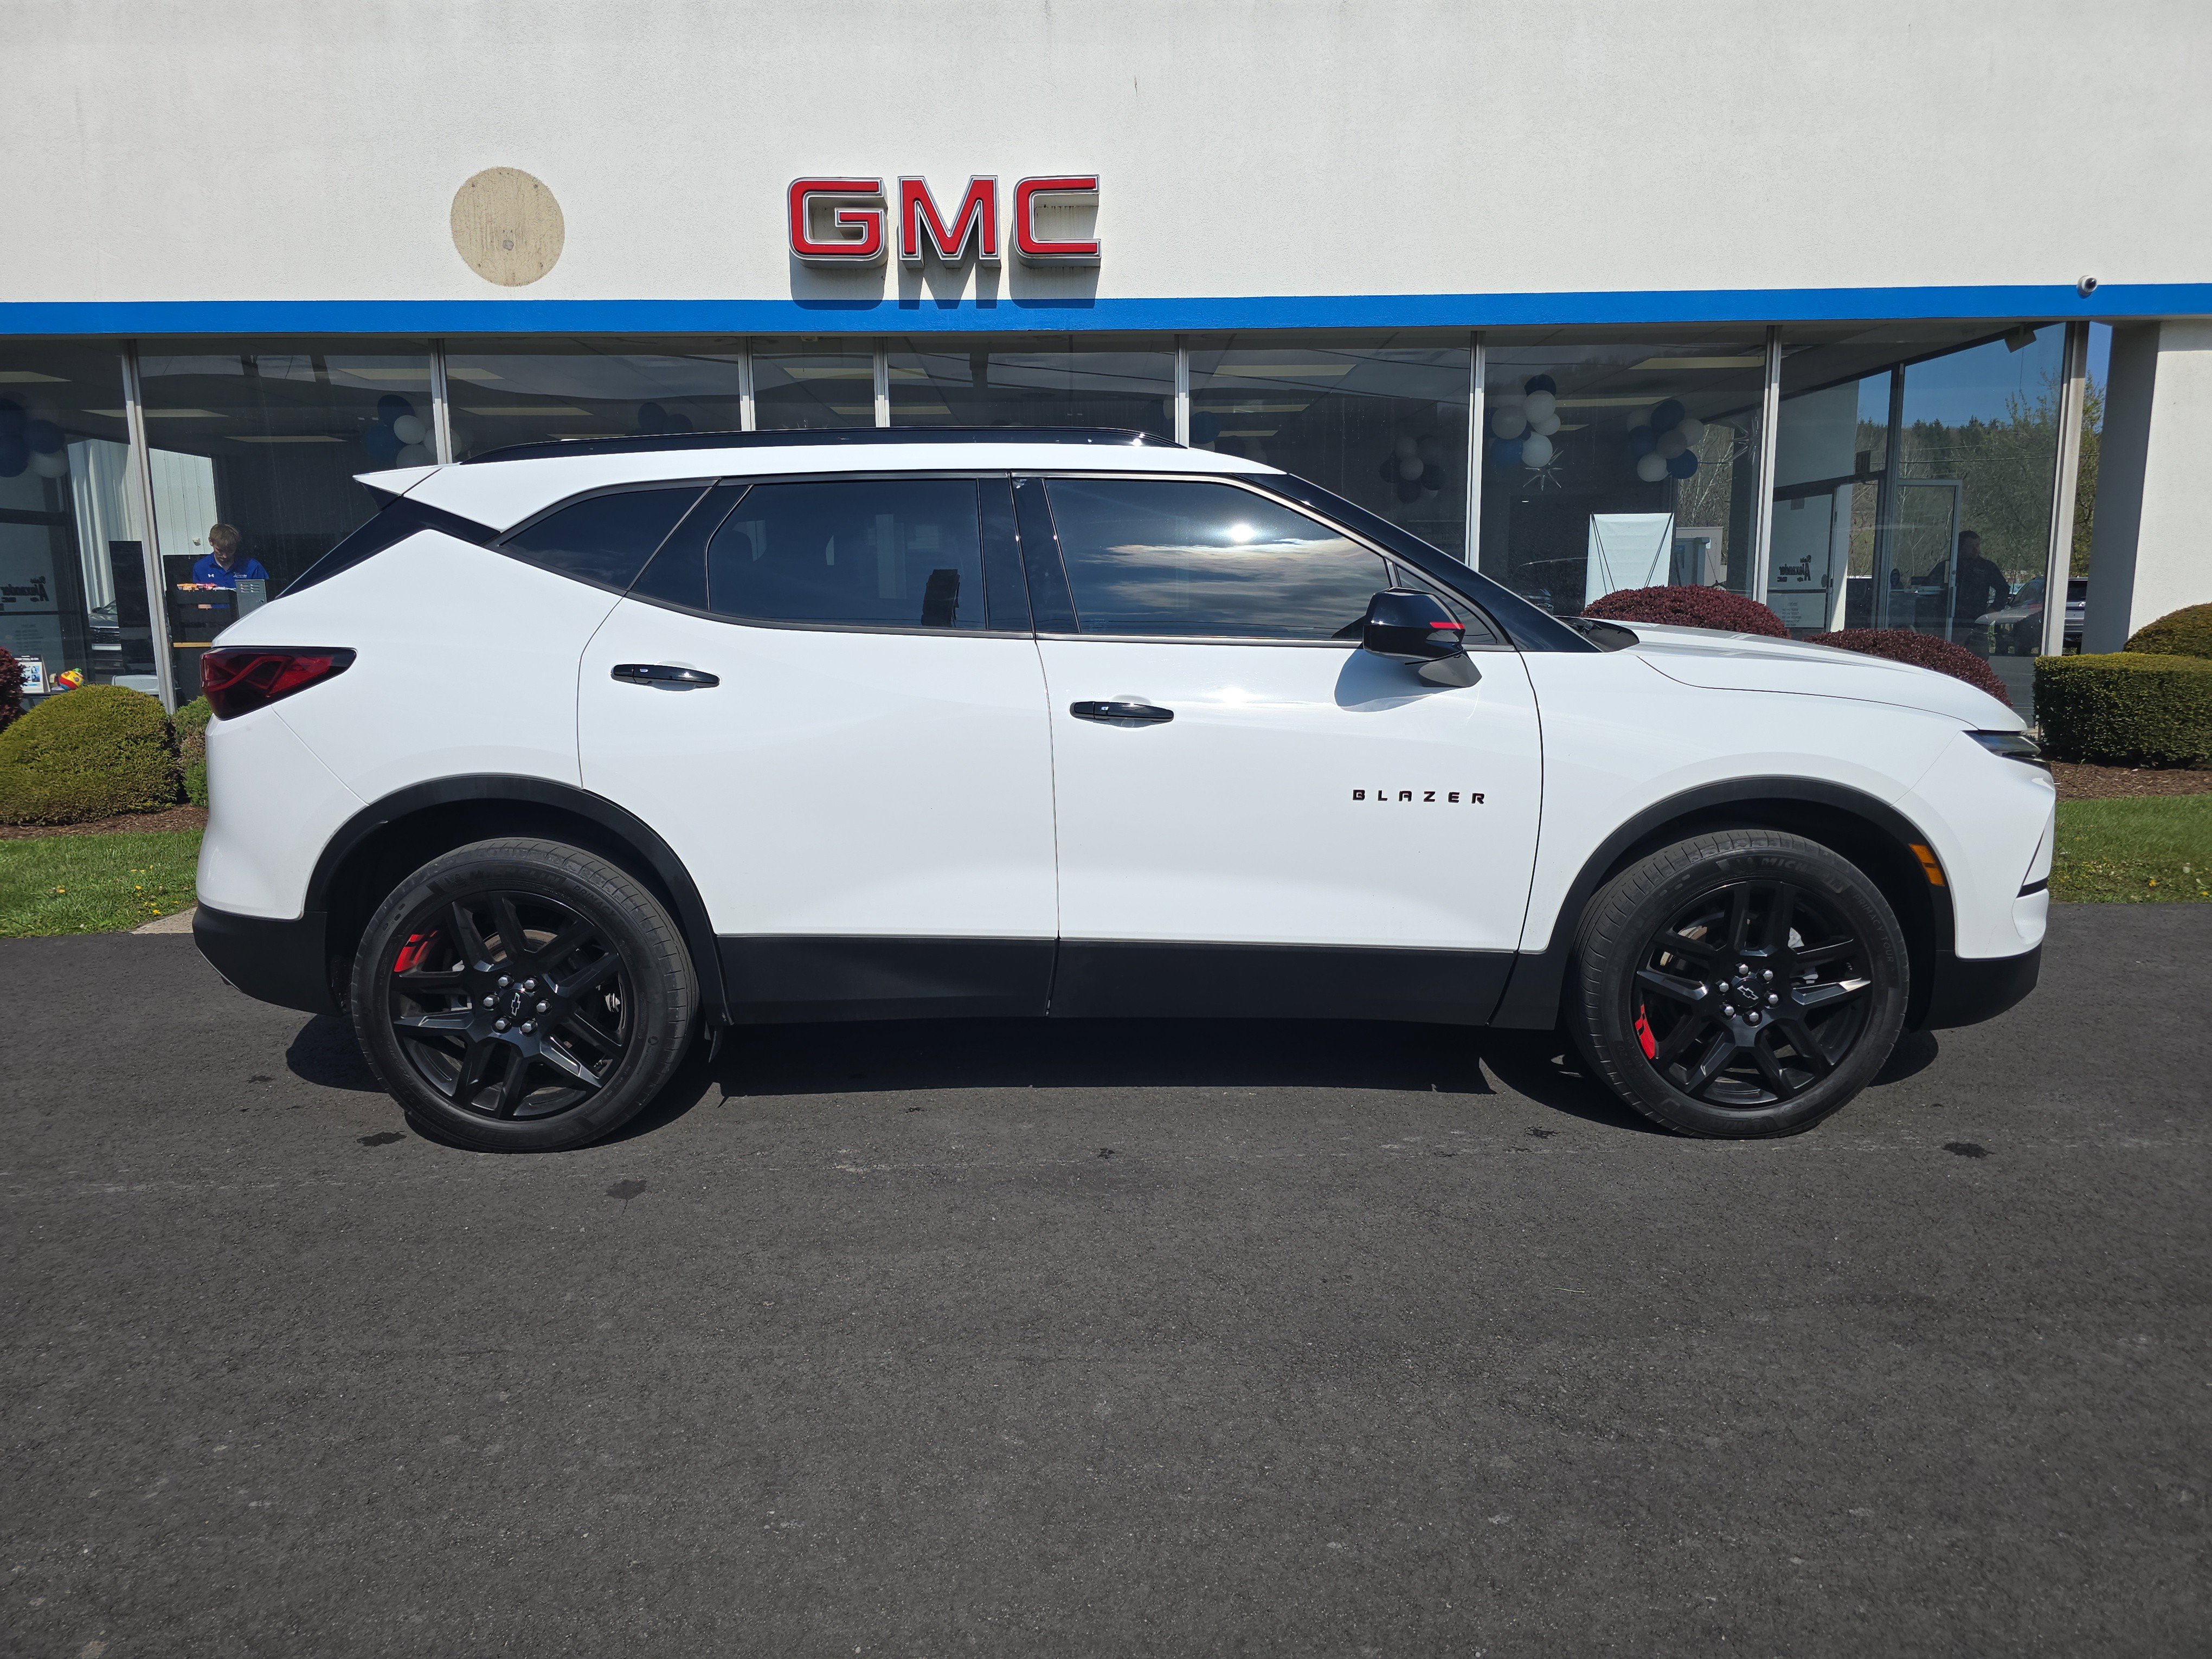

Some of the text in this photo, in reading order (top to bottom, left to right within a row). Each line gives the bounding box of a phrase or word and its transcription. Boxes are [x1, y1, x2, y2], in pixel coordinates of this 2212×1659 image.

[787, 174, 1102, 266] GMC
[1353, 789, 1484, 804] BLAZER
[1853, 894, 1894, 963] PRIMACY TOUR
